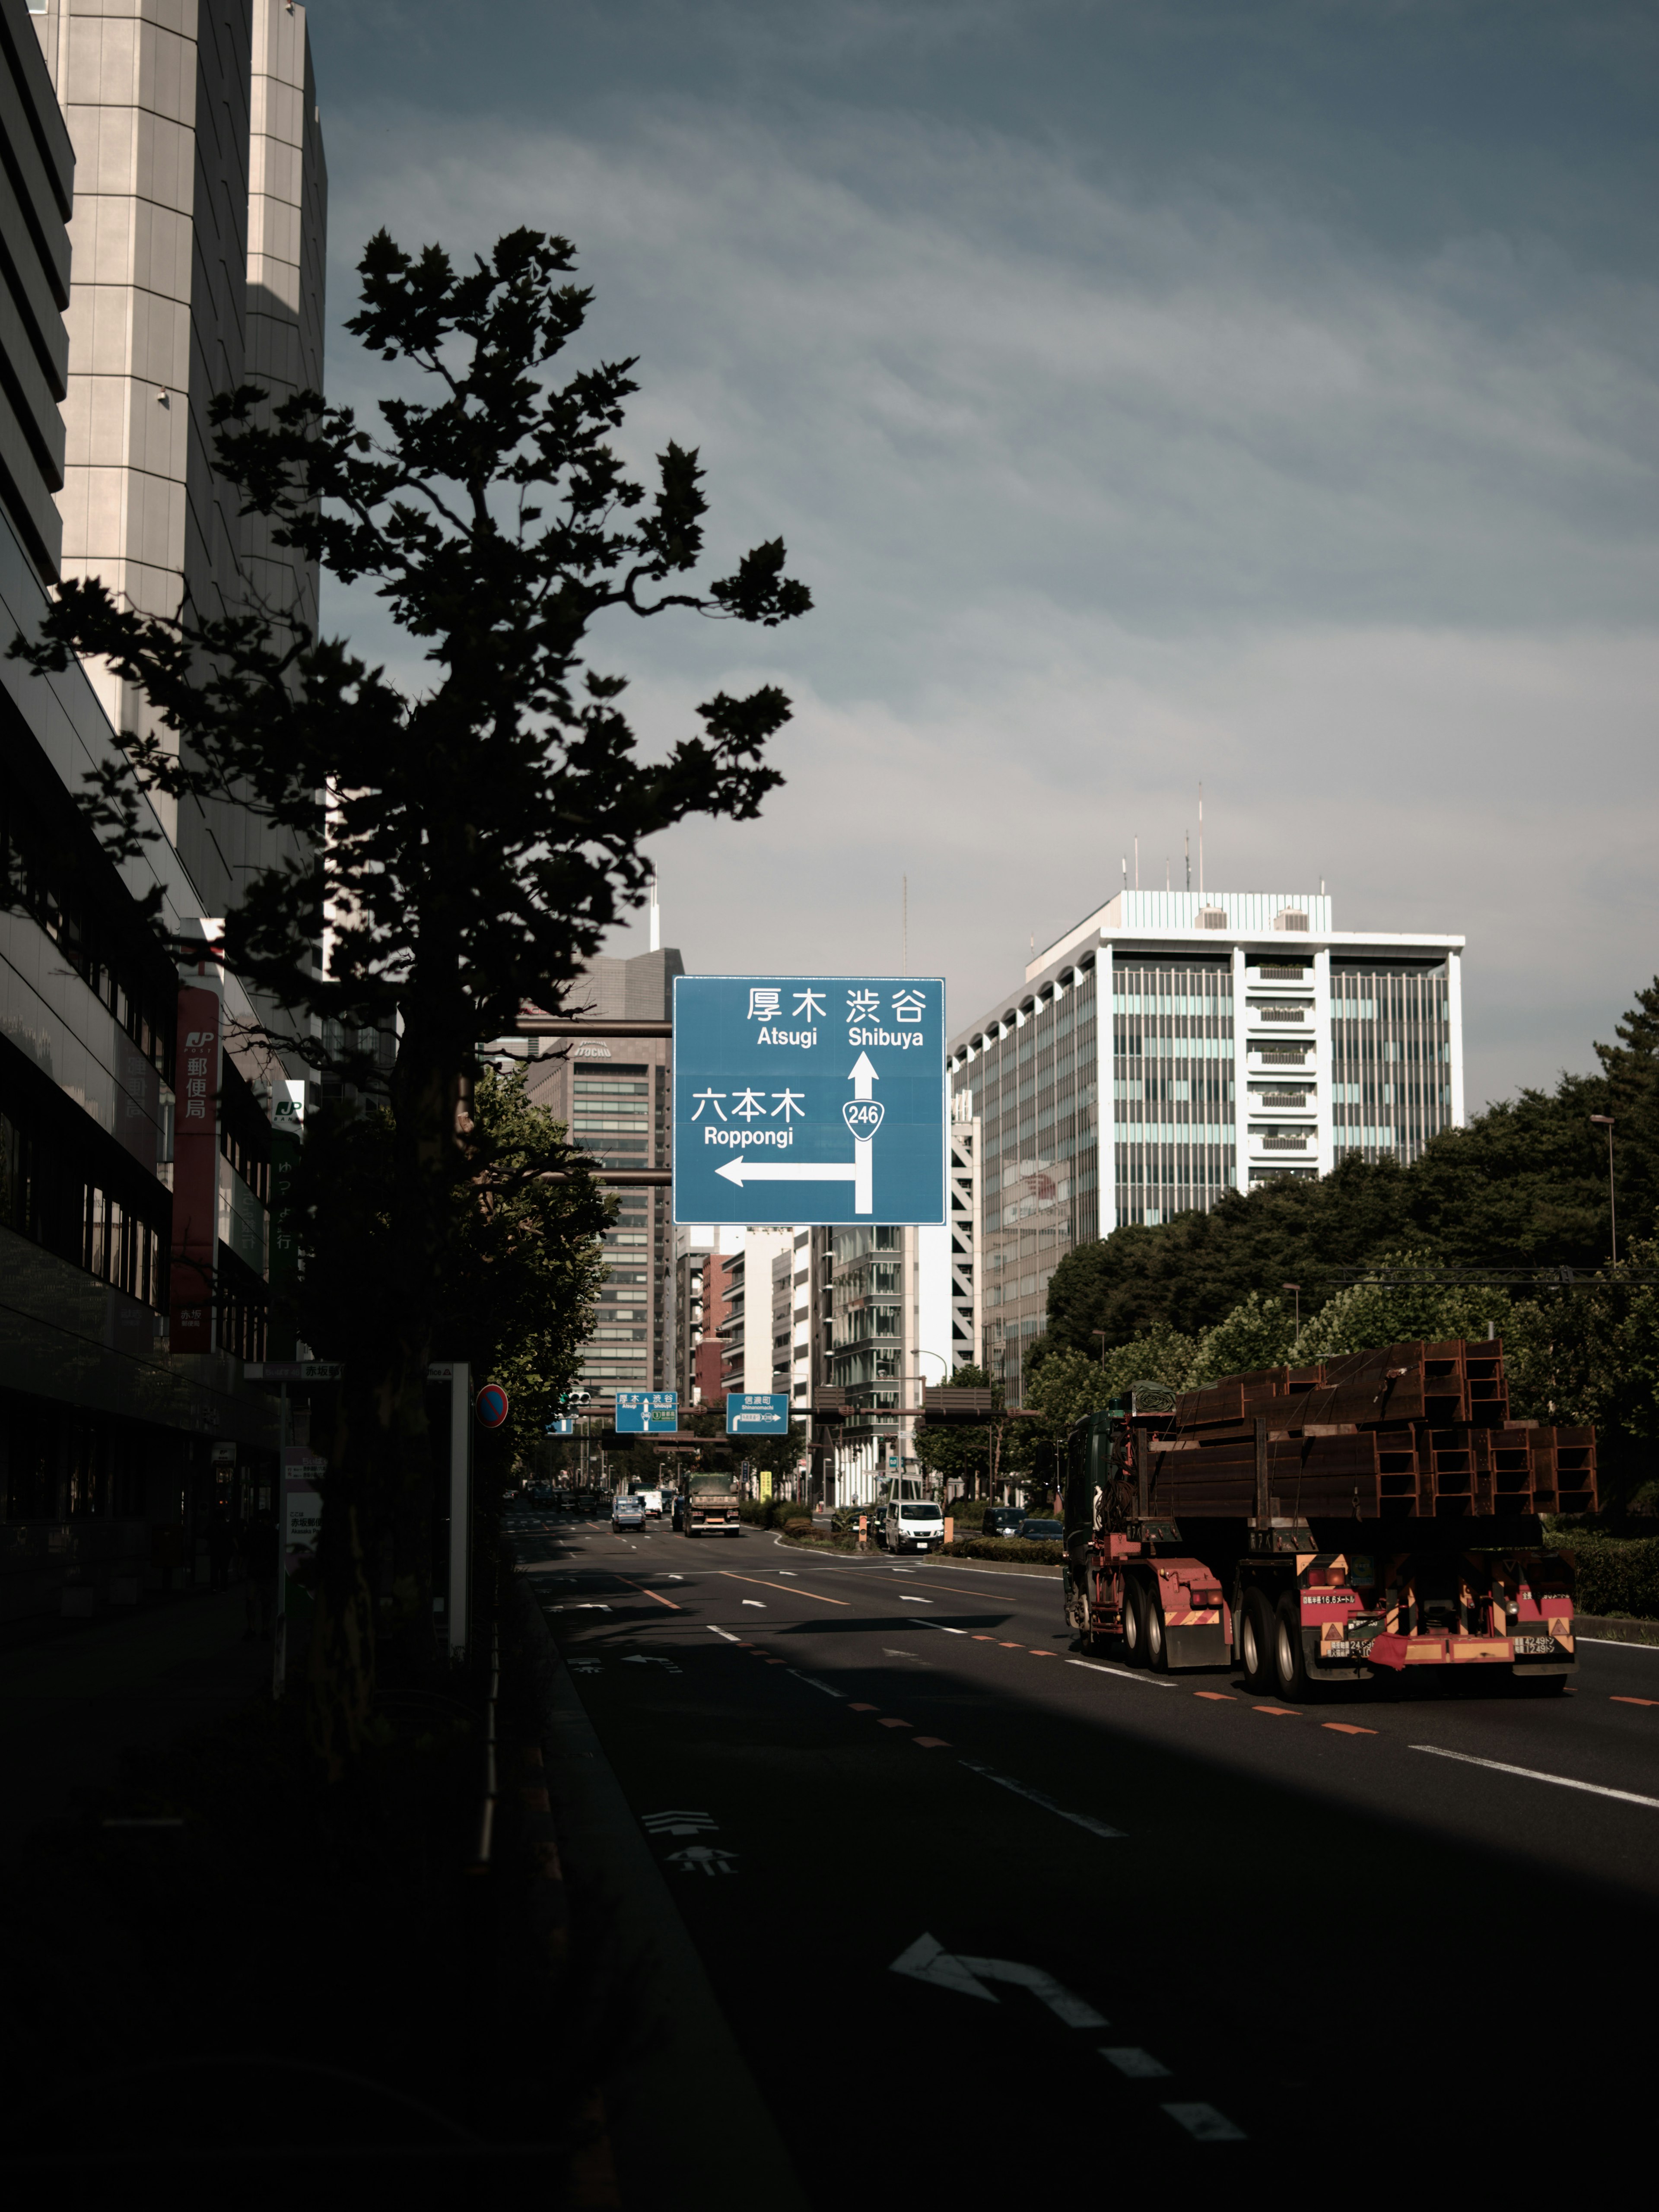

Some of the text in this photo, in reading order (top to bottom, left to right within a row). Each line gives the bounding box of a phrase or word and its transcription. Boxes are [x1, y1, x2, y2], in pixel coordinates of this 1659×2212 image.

[747, 988, 826, 1022] 厚木
[846, 988, 926, 1023] 渋谷
[186, 1032, 214, 1047] JP
[757, 1027, 817, 1049] Atsugi
[848, 1027, 923, 1049] Shibuya
[575, 1041, 612, 1057] ITOCHU
[185, 1057, 207, 1119] 郵便局
[276, 1102, 302, 1116] JP
[691, 1087, 805, 1122] 六本木
[849, 1106, 878, 1124] 246
[705, 1126, 793, 1148] Roppongi
[181, 1309, 202, 1319] 赤坂
[619, 1394, 639, 1403] 厚木
[653, 1394, 673, 1403] 渋谷
[744, 1396, 771, 1405] 信濃町
